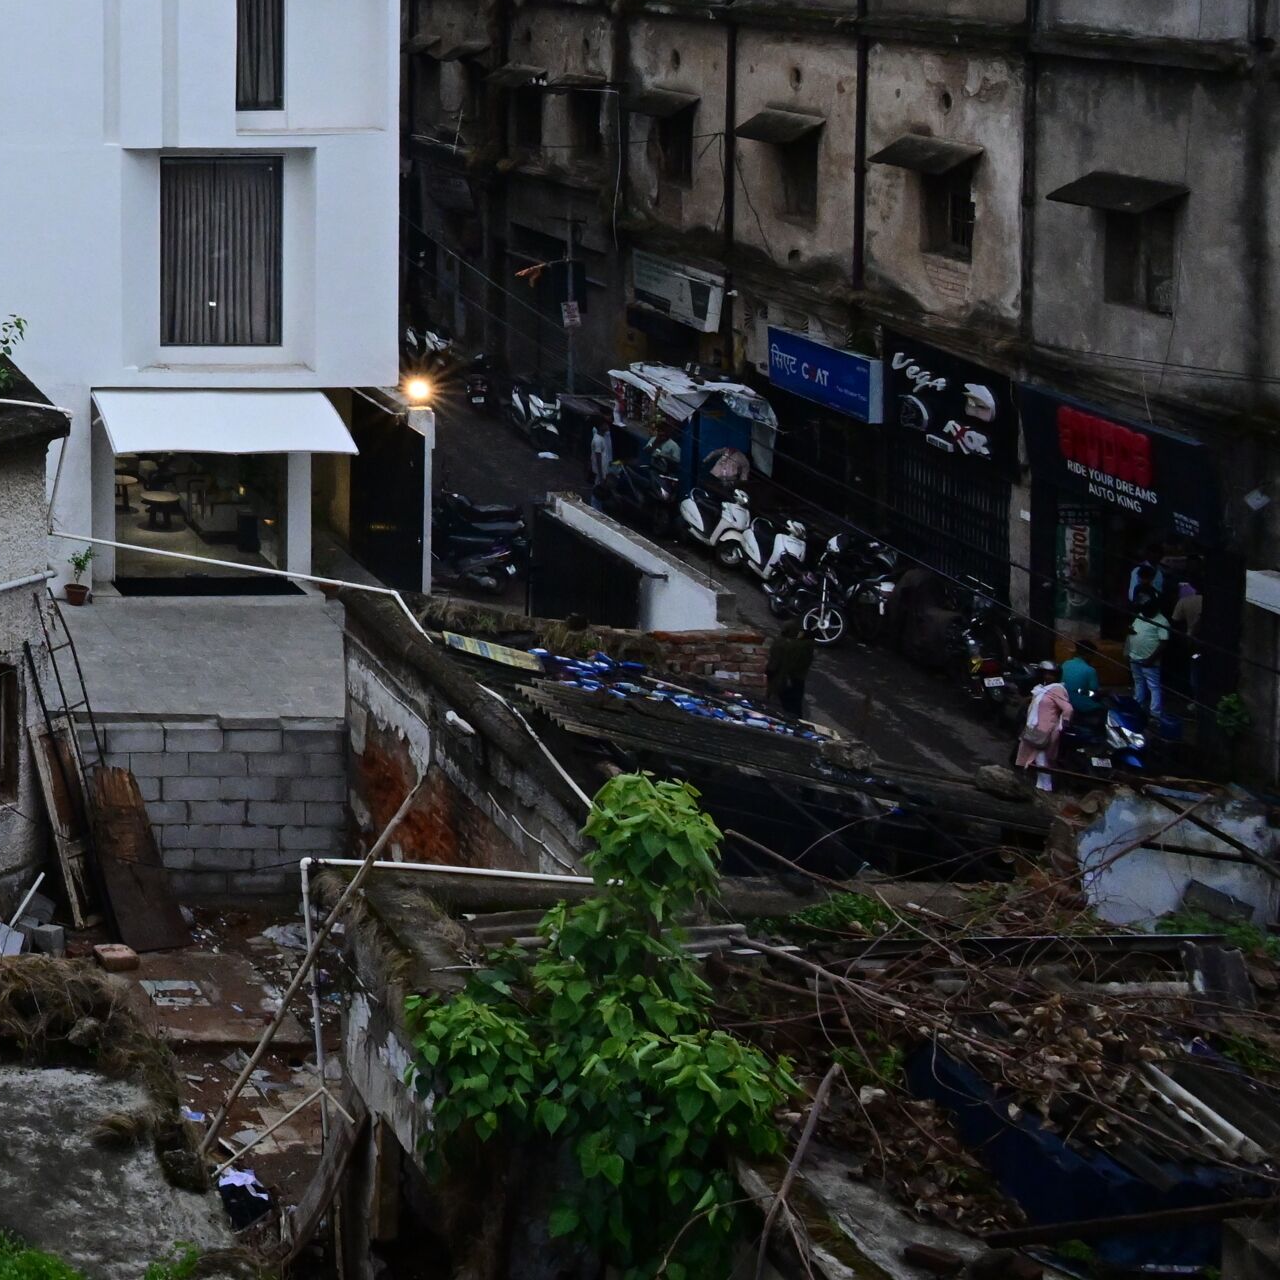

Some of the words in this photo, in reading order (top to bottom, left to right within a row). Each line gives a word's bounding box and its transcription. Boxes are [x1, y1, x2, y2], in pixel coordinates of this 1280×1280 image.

[770, 342, 798, 376] सिएट
[801, 361, 830, 388] CAT
[1066, 458, 1088, 478] RIDE
[1088, 467, 1115, 489] YOUR
[1115, 477, 1159, 505] DREAMS
[1087, 482, 1115, 504] AUTO
[1116, 493, 1143, 514] KING
[1071, 524, 1088, 580] astrol
